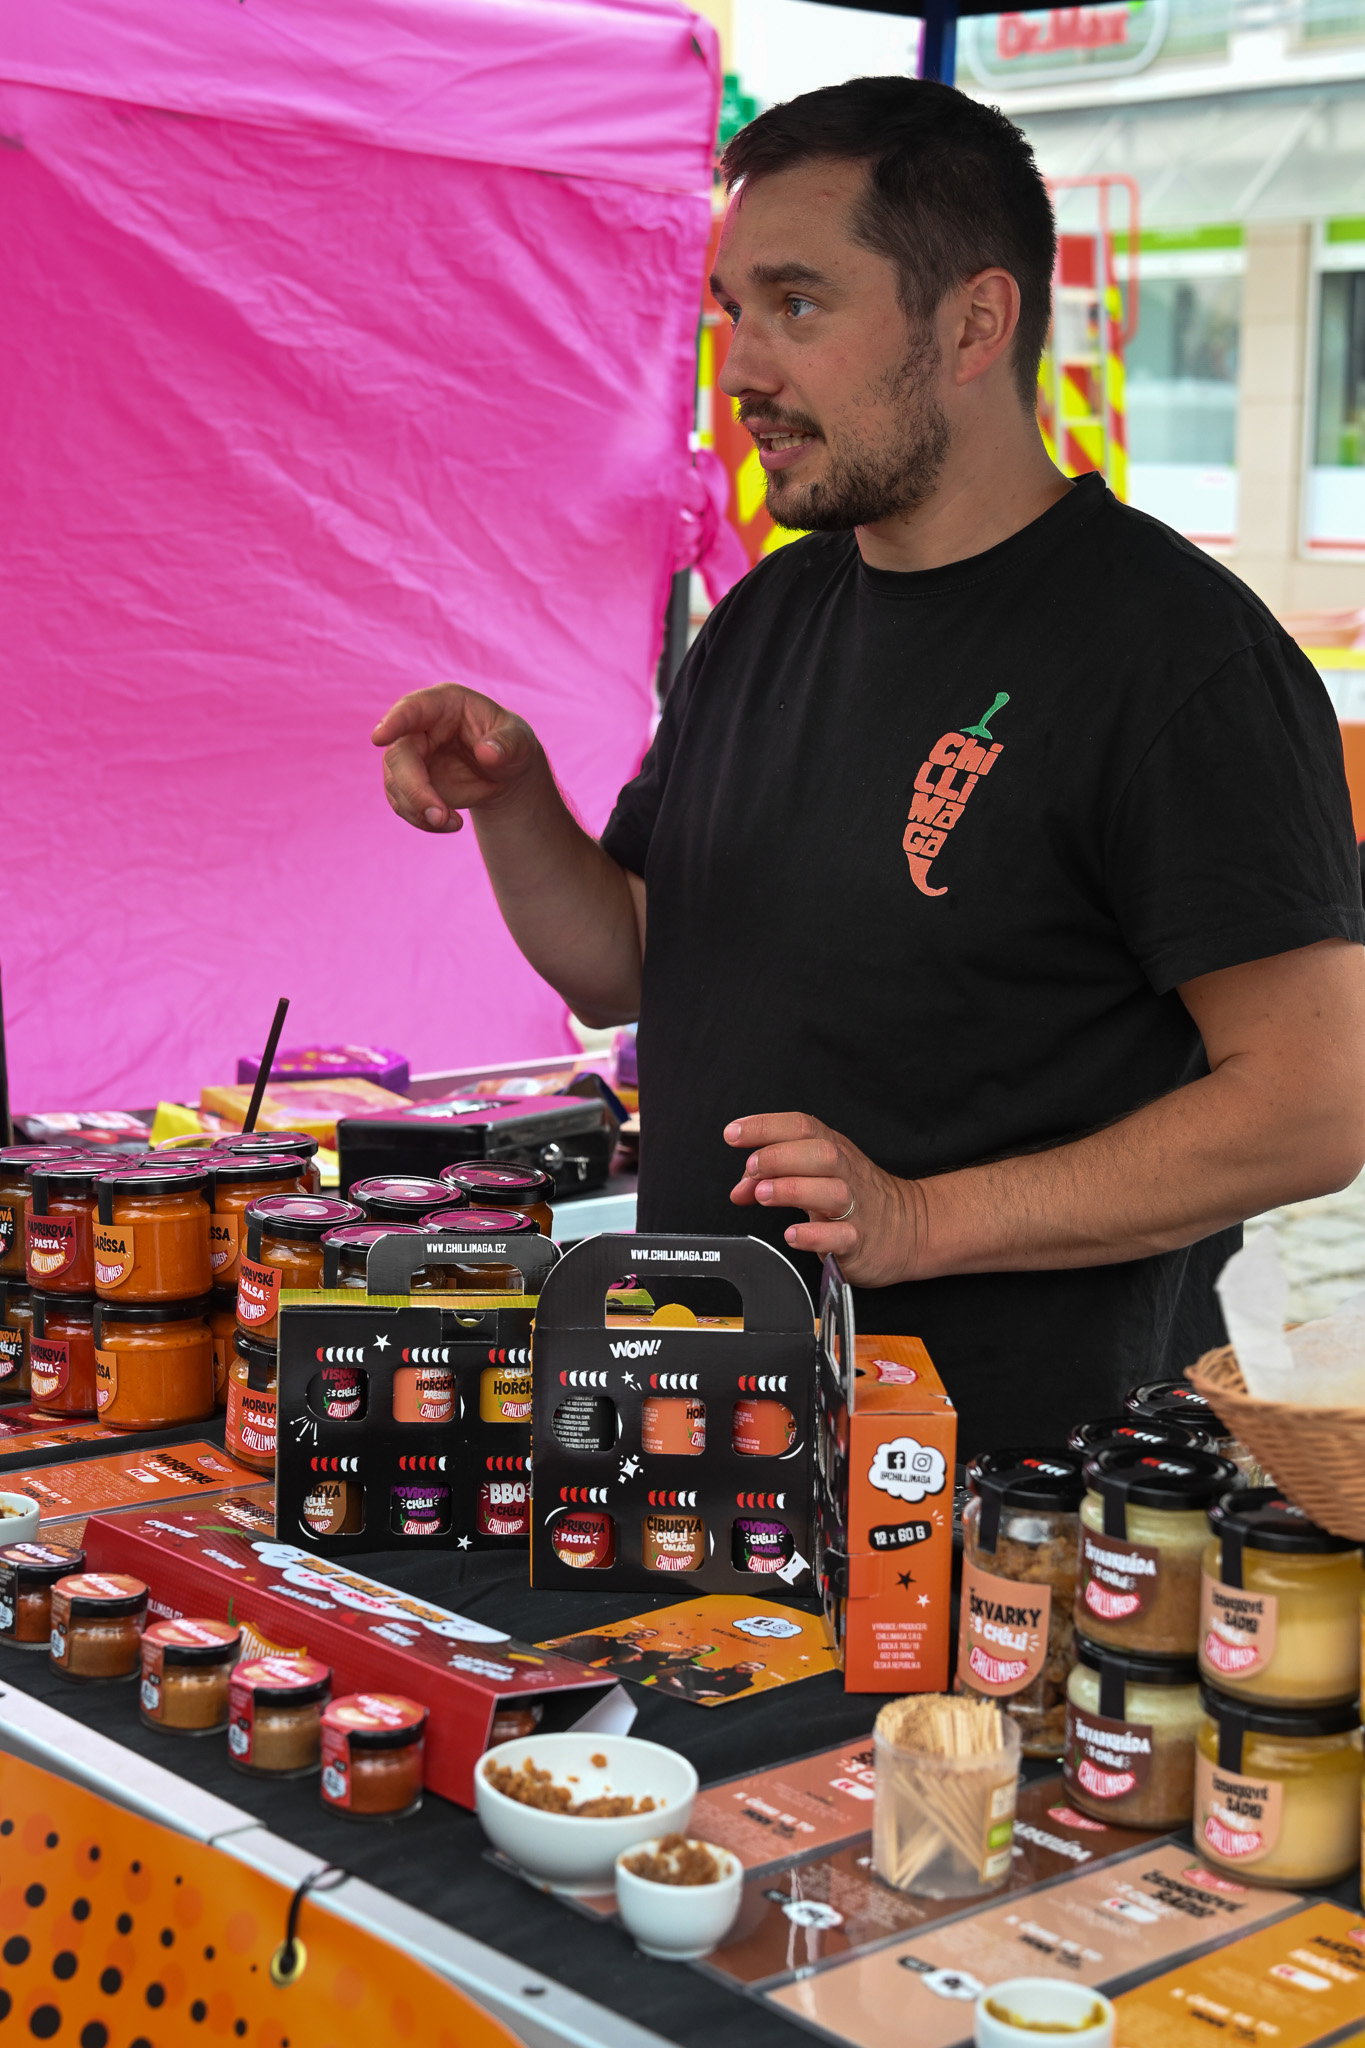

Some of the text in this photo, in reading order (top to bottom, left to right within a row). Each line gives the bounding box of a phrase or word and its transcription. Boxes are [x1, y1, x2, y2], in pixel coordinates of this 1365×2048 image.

[34, 1238, 60, 1249] PASTA
[426, 1243, 507, 1254] WWW.CHILLIMAGA.CZ
[630, 1249, 721, 1262] WWW.CHILLIMAGA.COM
[241, 1278, 265, 1301] SALSA
[609, 1339, 662, 1359] WOW!
[33, 1359, 54, 1373] PASTA
[247, 1411, 276, 1429] SALS
[143, 1461, 193, 1484] SALSA
[489, 1482, 526, 1504] BBQ
[561, 1532, 592, 1544] PASTA
[897, 1527, 915, 1542] 60
[970, 1587, 1042, 1629] ŠKVARKY
